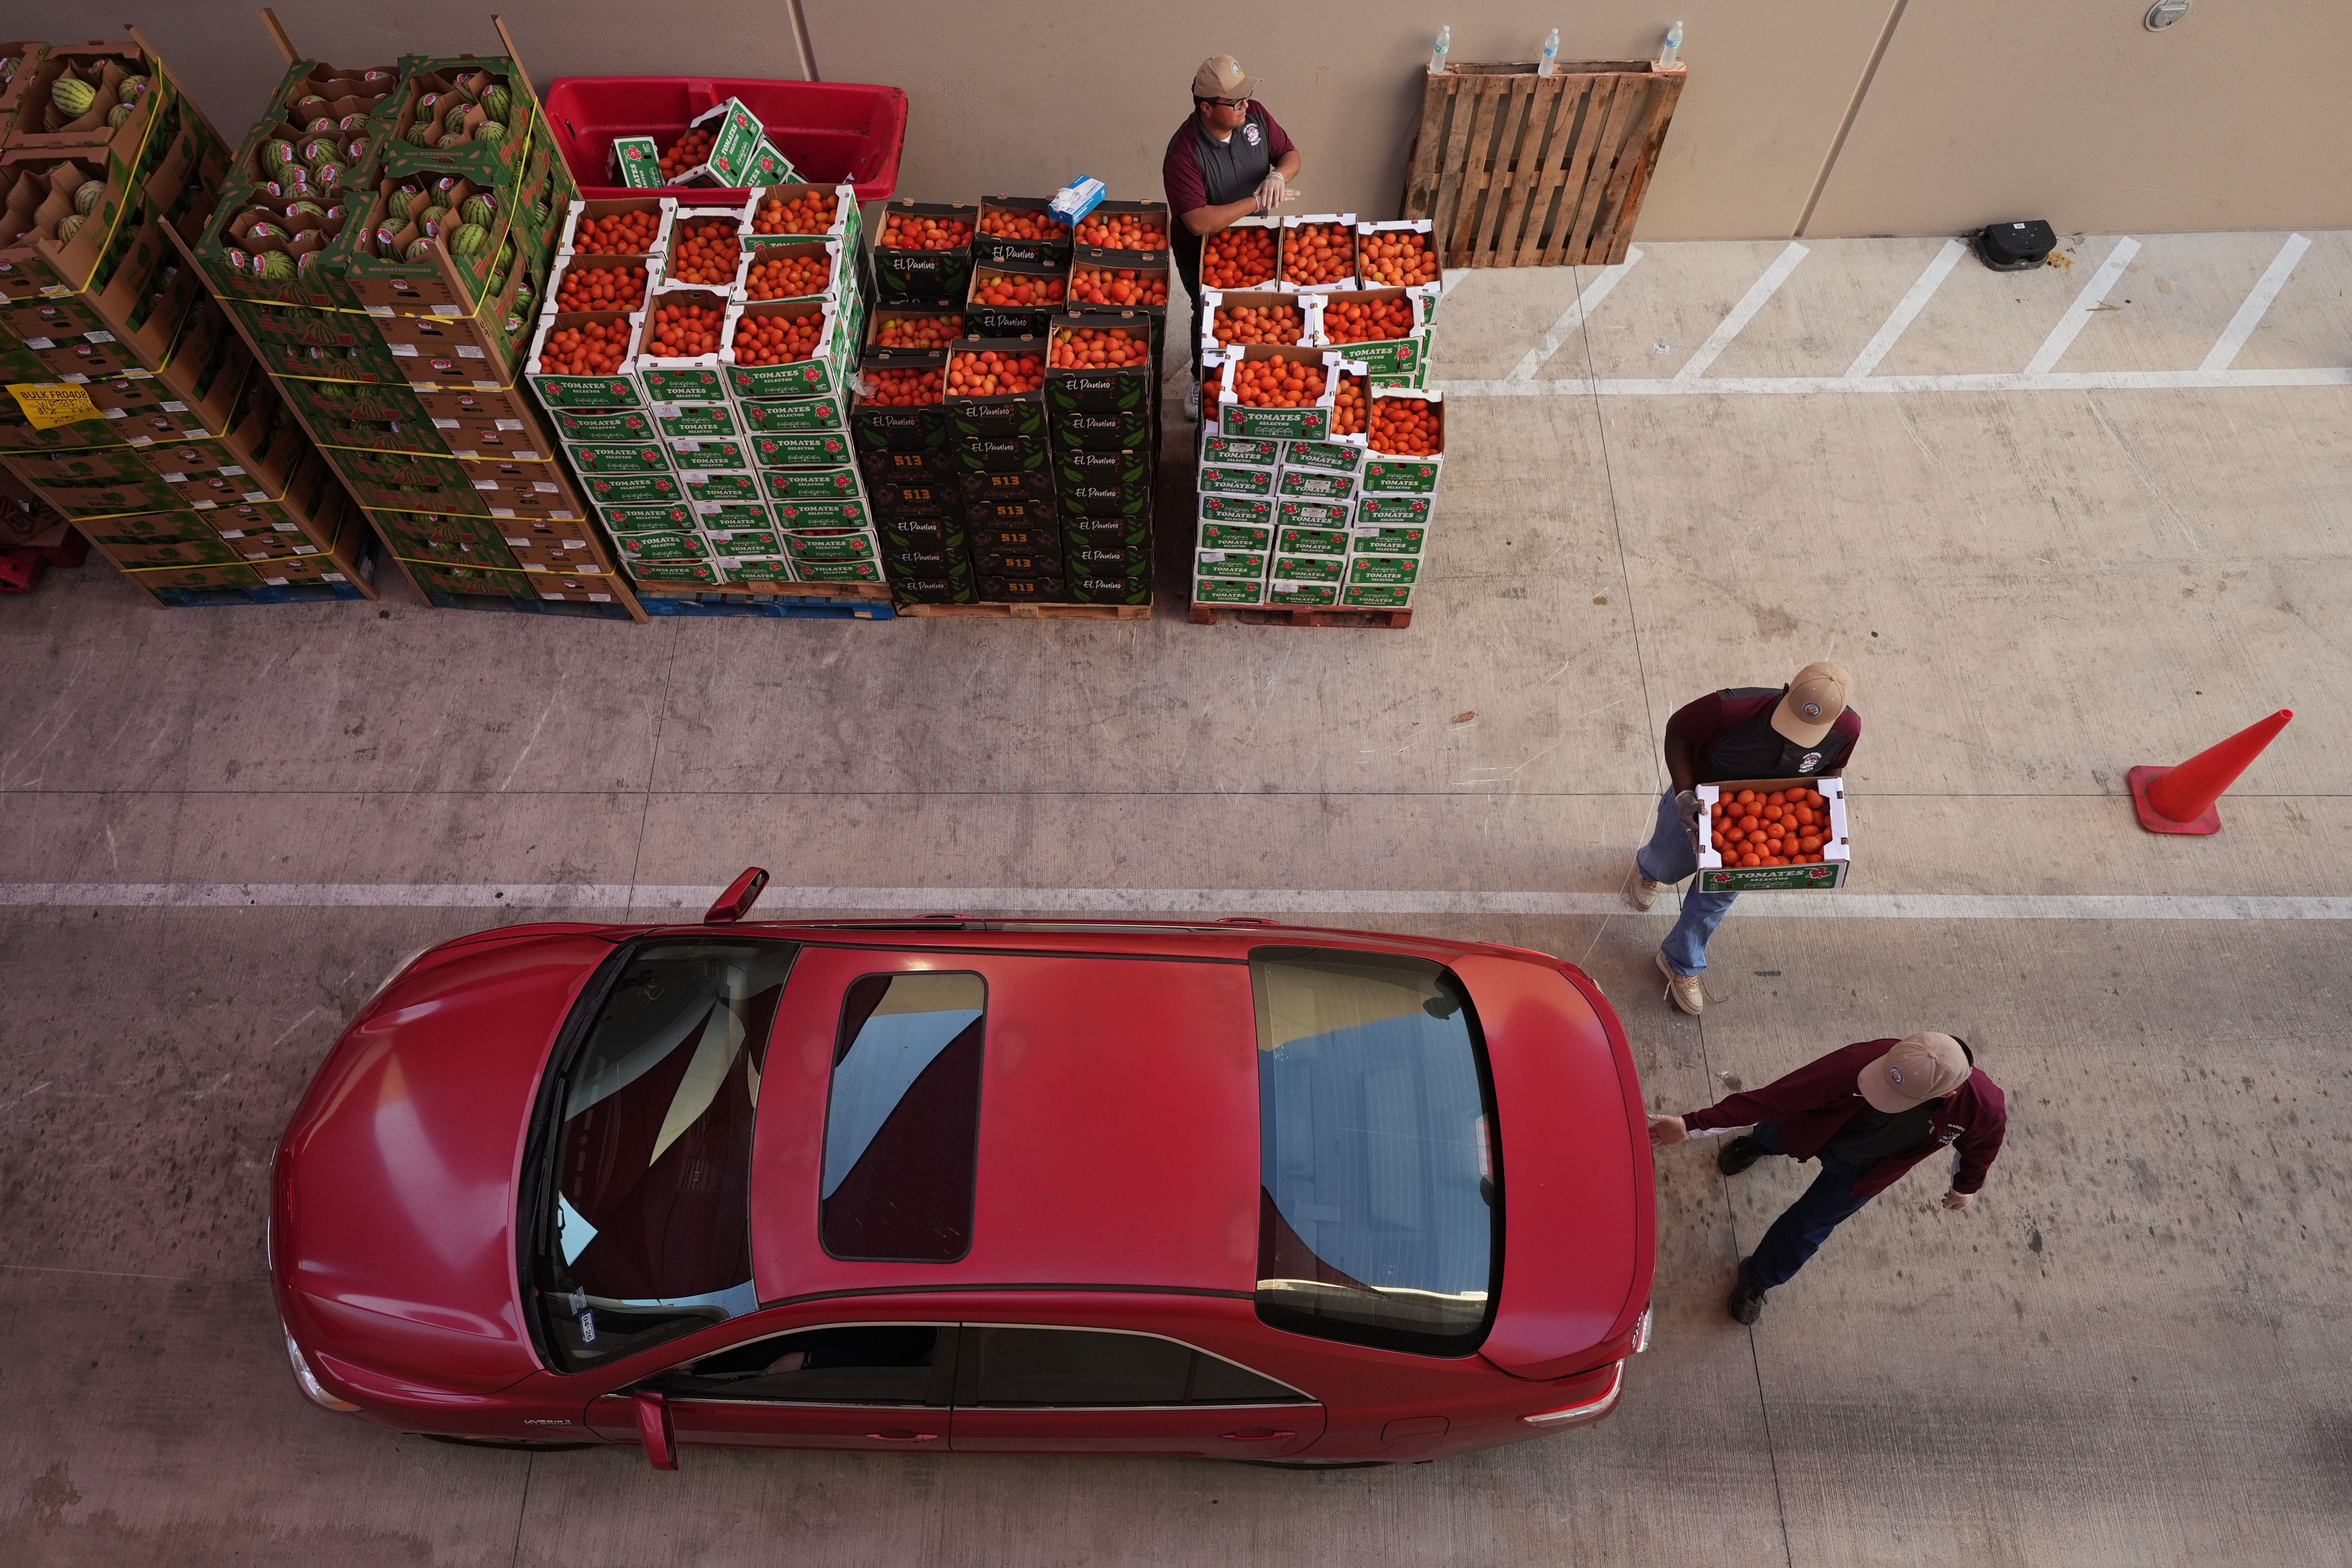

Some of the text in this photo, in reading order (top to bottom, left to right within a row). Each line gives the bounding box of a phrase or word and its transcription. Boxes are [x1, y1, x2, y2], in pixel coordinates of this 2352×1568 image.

[721, 123, 738, 155] TOMATES
[729, 134, 739, 155] SELECTOS
[631, 164, 641, 188] MATES
[745, 168, 760, 188] ATES
[1006, 246, 1034, 259] Panino
[906, 258, 935, 270] Panino
[998, 315, 1026, 327] Panino
[1349, 348, 1393, 357] TOMATES
[753, 370, 799, 378] TOMATES
[1080, 379, 1110, 390] Panino
[20, 391, 88, 399] BULK FR0408
[979, 406, 1009, 417] Panino
[885, 416, 915, 427] Panino
[1086, 418, 1116, 429] Panino
[984, 442, 1014, 452] Panino
[895, 456, 922, 465] 513
[1087, 455, 1115, 465] Panino
[1300, 455, 1343, 465] TOMATES
[992, 477, 1019, 485] 513
[1088, 488, 1116, 497] Panino
[1295, 485, 1337, 493] TOMATES
[903, 489, 930, 500] 513
[998, 506, 1023, 515] 513
[910, 521, 936, 531] Panino
[1092, 521, 1119, 530] Panino
[1002, 534, 1027, 542] 513
[913, 553, 939, 561] Panino
[1094, 551, 1120, 560] Panino
[1006, 559, 1031, 567] 513
[918, 582, 943, 590] Panino
[1010, 583, 1034, 591] 513
[1096, 580, 1121, 589] Panino
